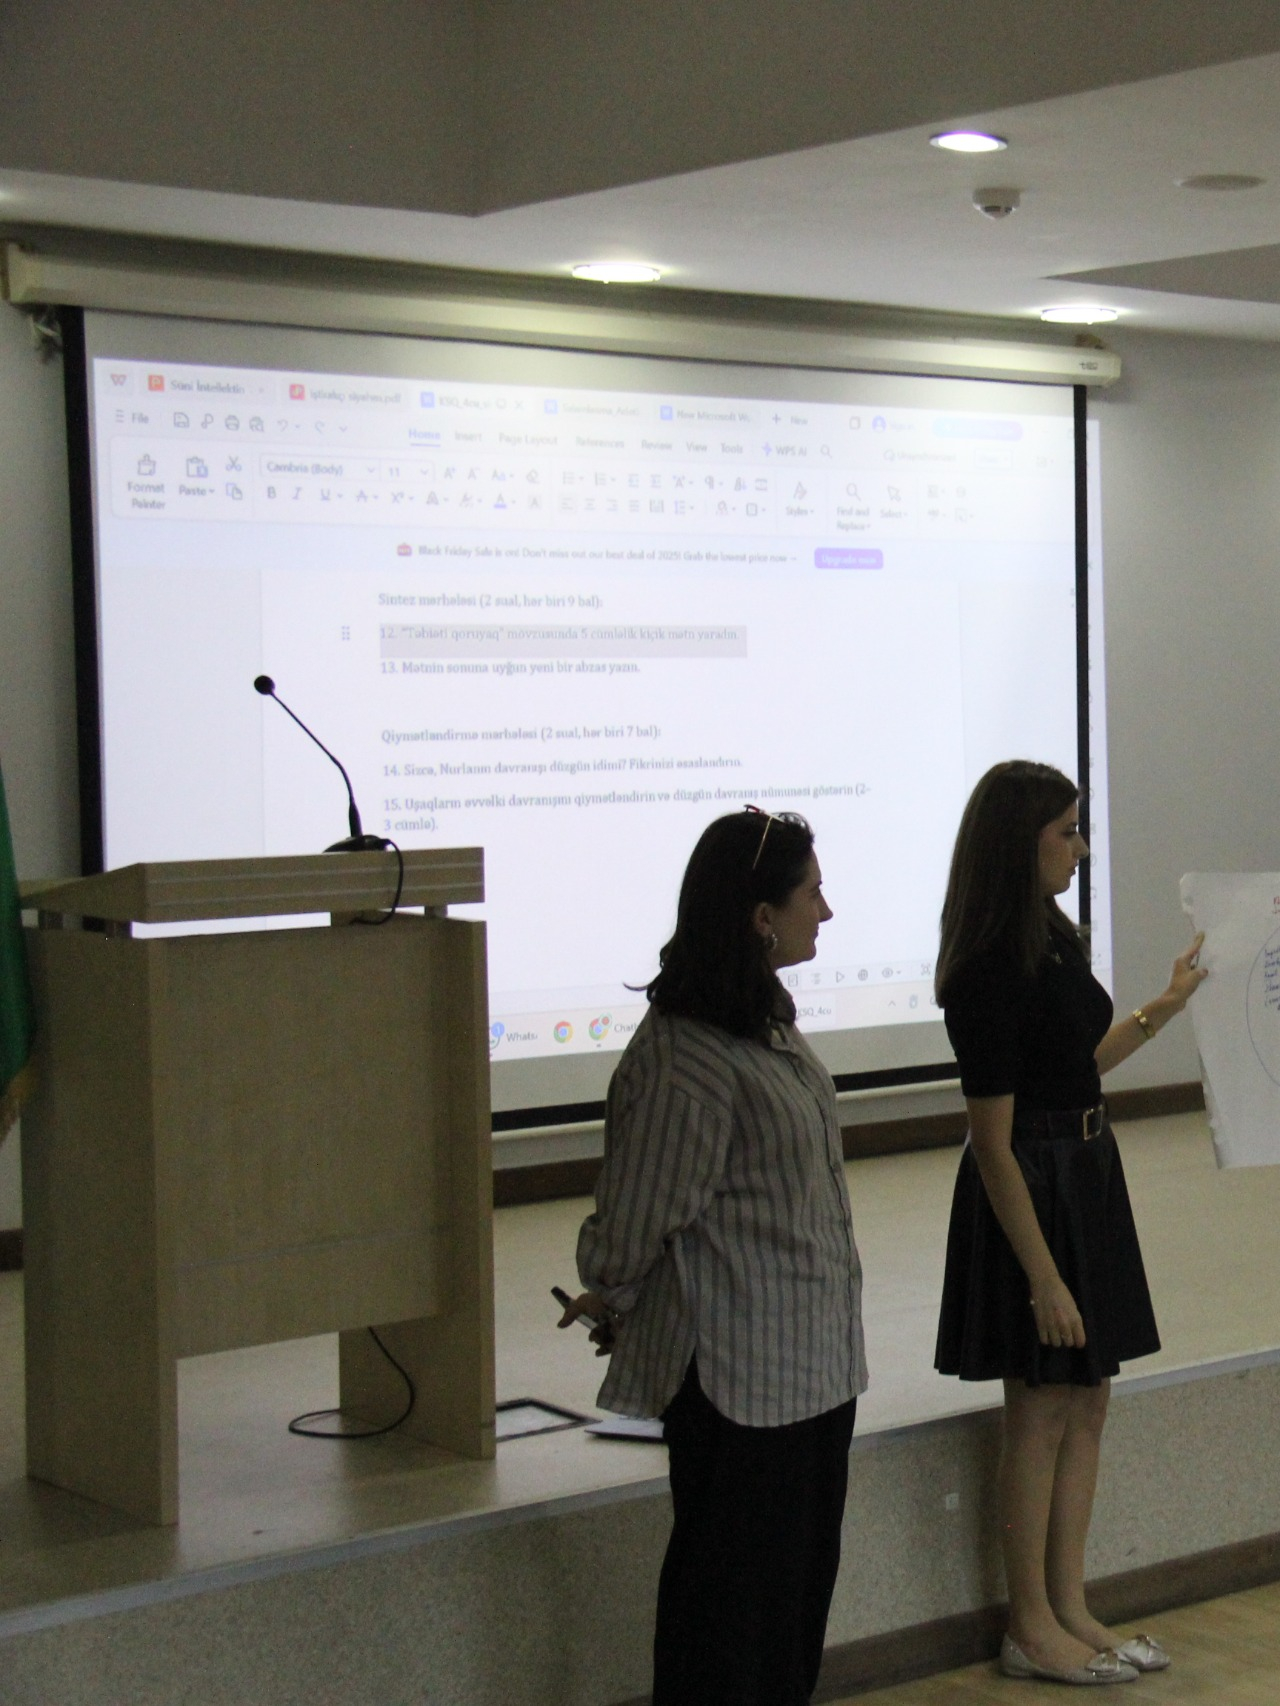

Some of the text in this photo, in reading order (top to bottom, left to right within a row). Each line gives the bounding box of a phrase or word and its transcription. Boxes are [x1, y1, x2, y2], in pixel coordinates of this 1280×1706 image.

[131, 412, 149, 425] File
[408, 428, 441, 441] Home
[454, 431, 483, 443] Insert
[498, 433, 557, 448] Page Layout
[641, 440, 673, 452] Review
[686, 442, 708, 454] View
[721, 443, 744, 455] Tools
[776, 446, 796, 458] WPS
[266, 460, 344, 477] Cambria (Body)
[127, 481, 165, 494] Format
[179, 484, 208, 498] Paste
[132, 498, 166, 512] Painter
[786, 504, 810, 518] Styles
[419, 545, 442, 556] Black
[445, 547, 472, 560] Friday
[522, 549, 547, 560] Don't
[549, 549, 570, 560] miss
[572, 550, 587, 560] out
[589, 550, 604, 560] our
[606, 549, 624, 561] best
[627, 550, 644, 561] deal
[684, 552, 704, 562] Grab
[706, 552, 719, 561] the
[721, 553, 746, 562] lowest
[749, 554, 768, 564] price
[378, 593, 416, 607] Sintez
[419, 593, 477, 608] mərhələsi
[495, 595, 521, 609] sual,
[524, 593, 542, 608] hər
[546, 594, 565, 608] biri
[380, 627, 398, 640] 12.
[507, 628, 578, 641] mövzusunda
[591, 628, 637, 641] cümləlik
[639, 628, 665, 643] kiçik
[668, 629, 695, 641] mətn
[381, 662, 398, 674] 13.
[402, 661, 444, 673] Mətnin
[446, 662, 489, 673] sonuna
[492, 661, 527, 676] uyğun
[530, 661, 554, 676] yeni
[557, 660, 573, 673] bir
[575, 660, 606, 673] abzas
[381, 729, 478, 745] Qiymətləndirmə
[481, 728, 537, 741] mərhələsi
[556, 727, 581, 741] sual,
[583, 727, 600, 738] hər
[604, 726, 624, 738] biri
[636, 725, 662, 739] bal):
[383, 765, 400, 777] 14.
[404, 764, 436, 777] Sizcə,
[549, 759, 590, 775] düzgün
[593, 758, 627, 771] idimi?
[629, 758, 674, 771] Fikrinizi
[383, 800, 401, 812] 15.
[464, 796, 505, 809] əvvəlki
[574, 790, 656, 808] qiymətləndirin
[658, 793, 670, 803] və
[673, 788, 712, 805] düzgün
[714, 788, 758, 803] davranış
[760, 786, 811, 800] nümunəsi
[813, 784, 854, 800] göstərin
[394, 818, 439, 833] cümlə).
